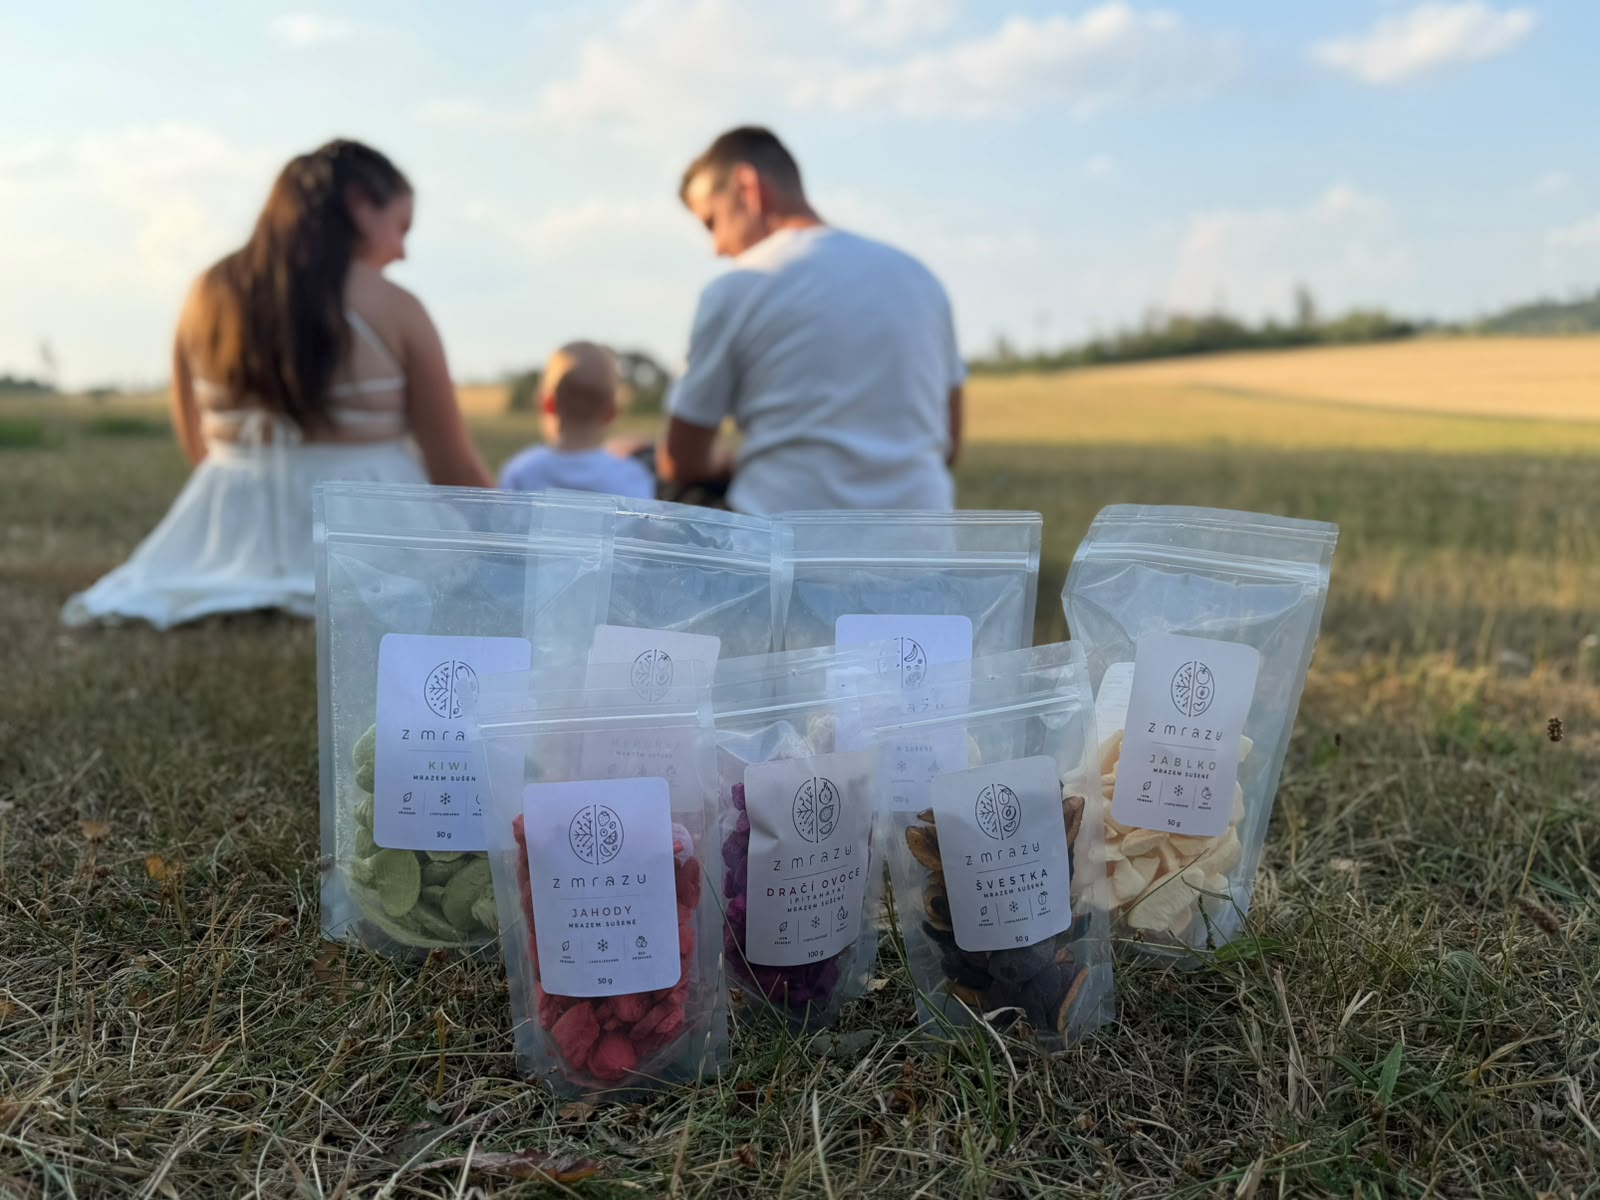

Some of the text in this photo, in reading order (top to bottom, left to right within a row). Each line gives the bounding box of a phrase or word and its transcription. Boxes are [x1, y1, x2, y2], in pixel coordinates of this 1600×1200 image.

[429, 761, 468, 771] KIWI
[1150, 754, 1216, 771] JABLKO
[1153, 768, 1182, 776] MRAZEM
[1176, 820, 1181, 828] g
[436, 831, 446, 839] 50
[766, 867, 860, 897] DRAČÍ OVOCE
[975, 868, 1049, 891] ŠVESTKA
[983, 889, 1014, 898] MRAZEM
[572, 905, 632, 918] JAHODY
[787, 903, 818, 913] MRAZEM
[605, 918, 637, 927] SUŠENÉ
[808, 950, 819, 958] 100
[597, 977, 607, 985] 50
